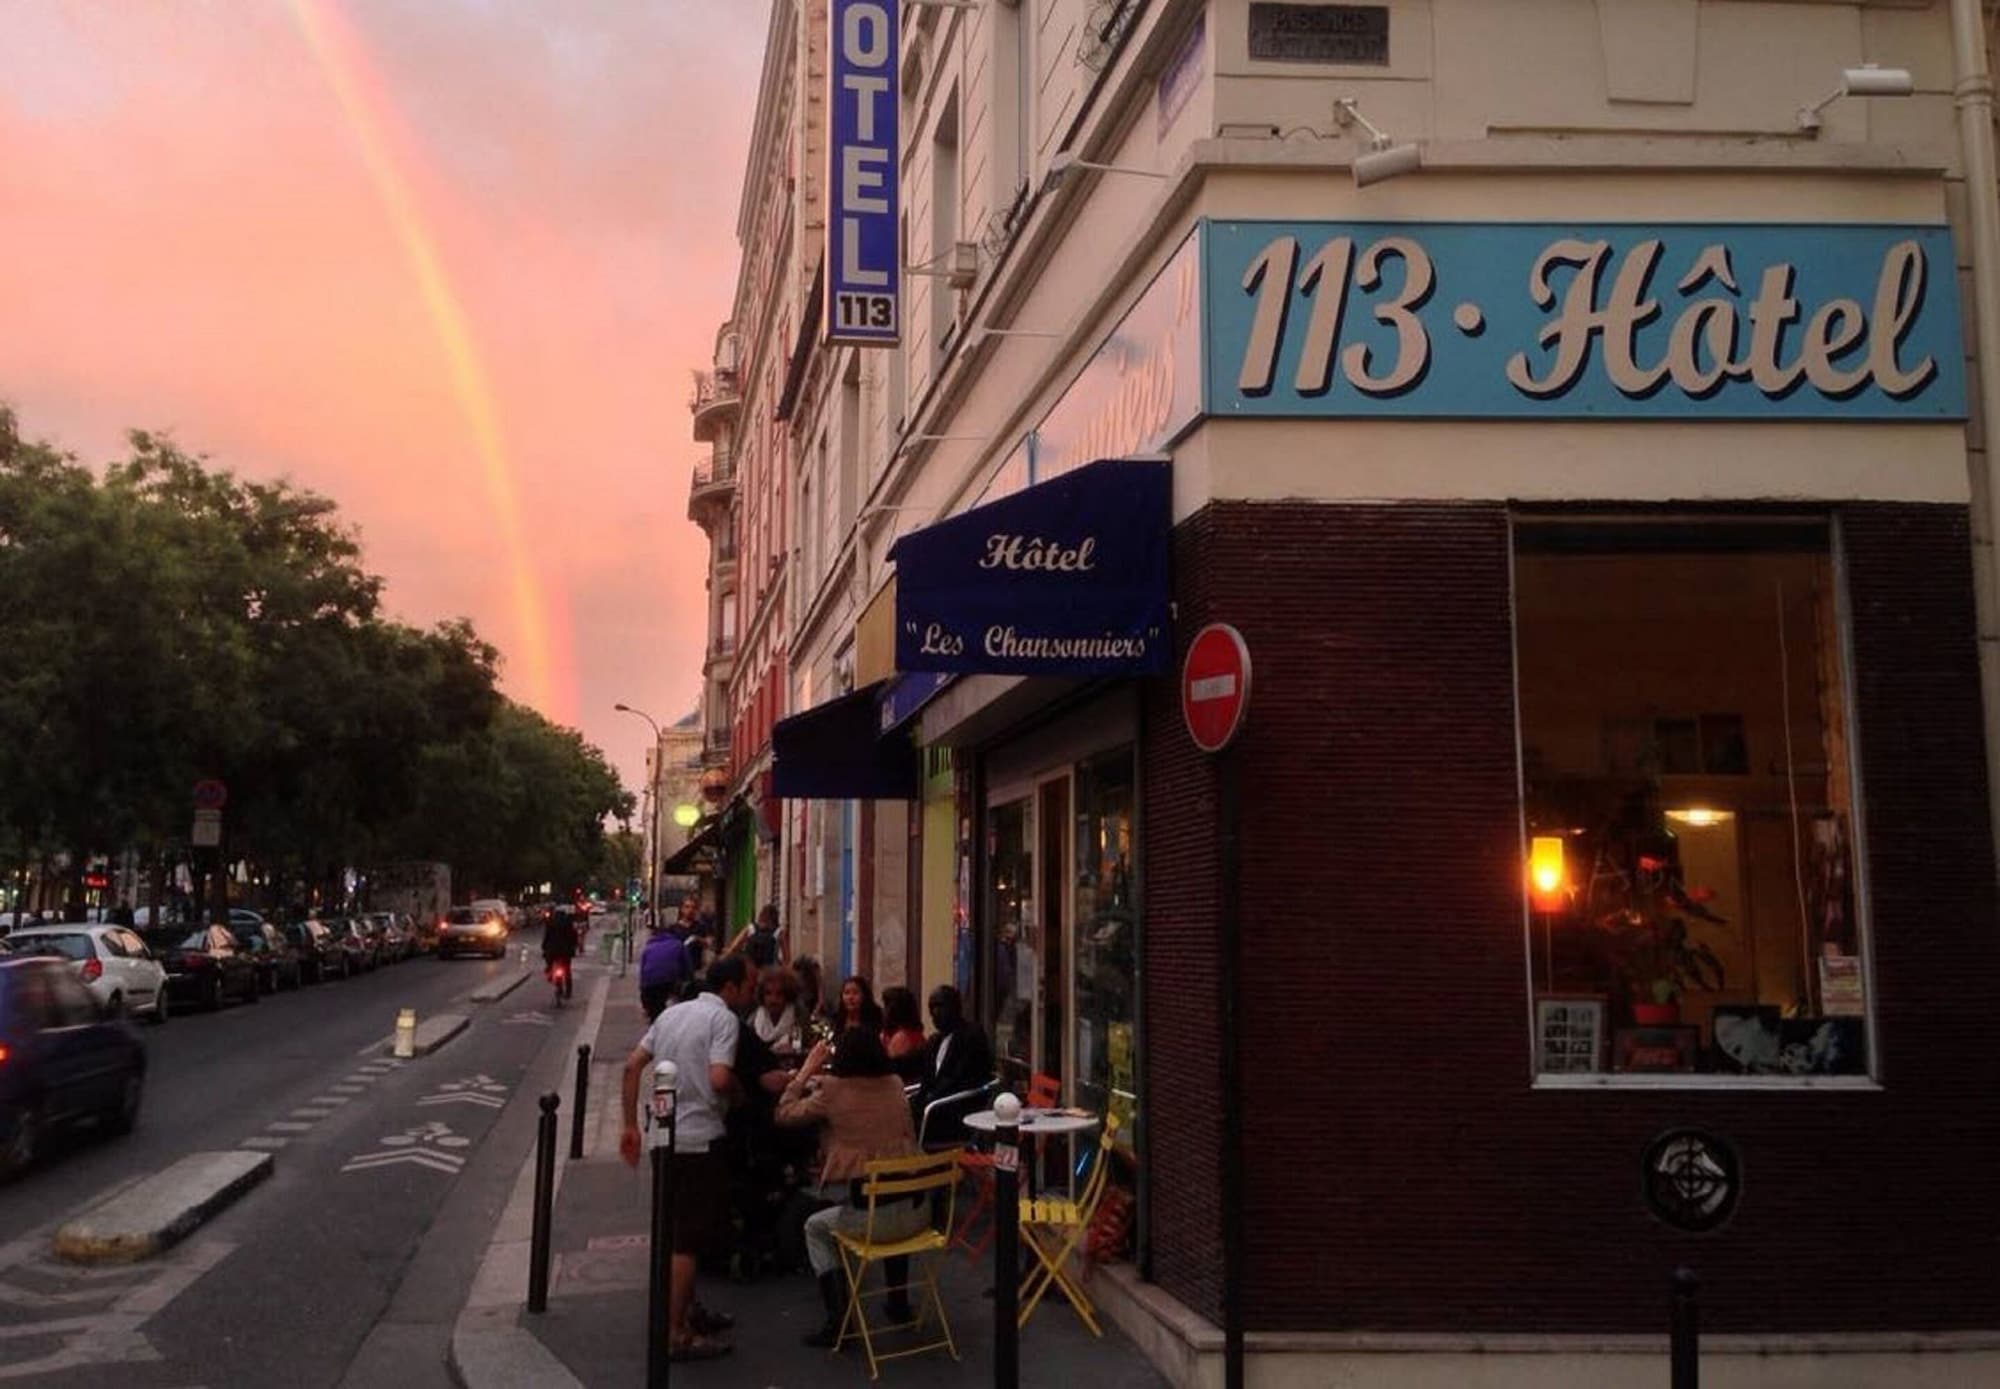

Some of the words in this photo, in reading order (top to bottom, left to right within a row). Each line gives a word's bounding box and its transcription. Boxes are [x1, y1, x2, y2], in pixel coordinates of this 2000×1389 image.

[843, 3, 888, 285] OTEL
[839, 295, 892, 327] 113
[1239, 236, 1436, 397] 113
[1506, 237, 1939, 400] Hôtel
[978, 533, 1096, 572] Hôtel
